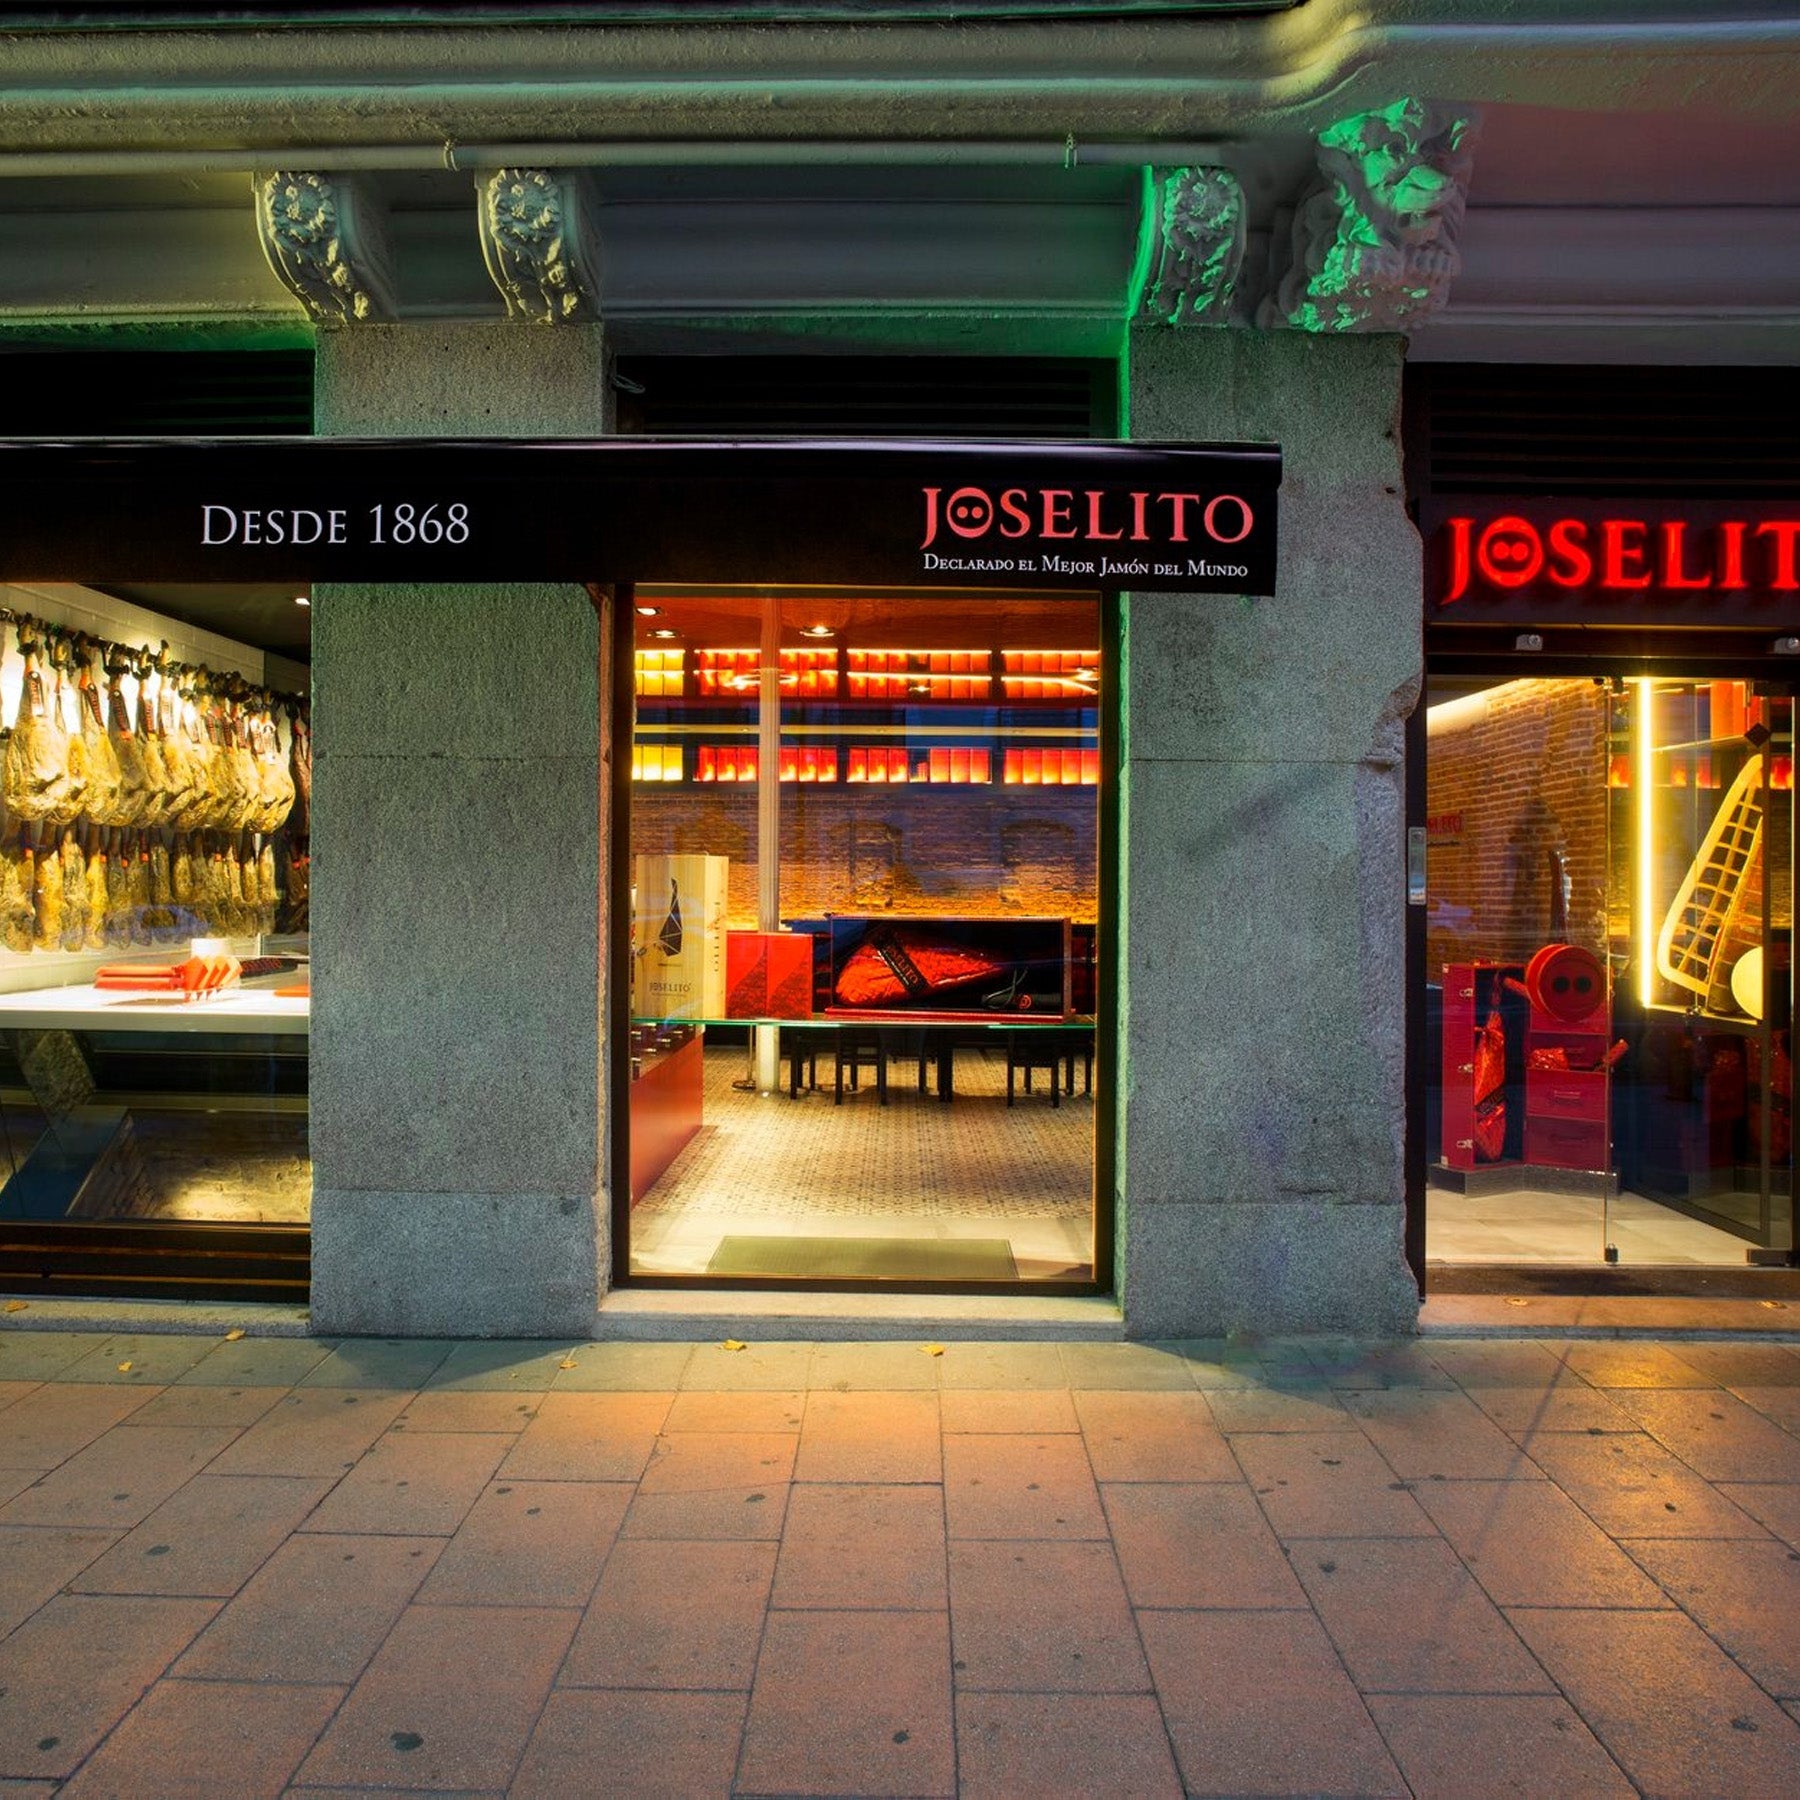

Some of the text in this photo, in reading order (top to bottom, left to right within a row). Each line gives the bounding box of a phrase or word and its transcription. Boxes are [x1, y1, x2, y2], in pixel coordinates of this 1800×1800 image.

[200, 503, 470, 545] DESDE 1868
[919, 486, 1255, 550] JOSELITO
[923, 553, 1249, 577] DECLARADO EL MEJOR JAMÓN DEL MUNDO
